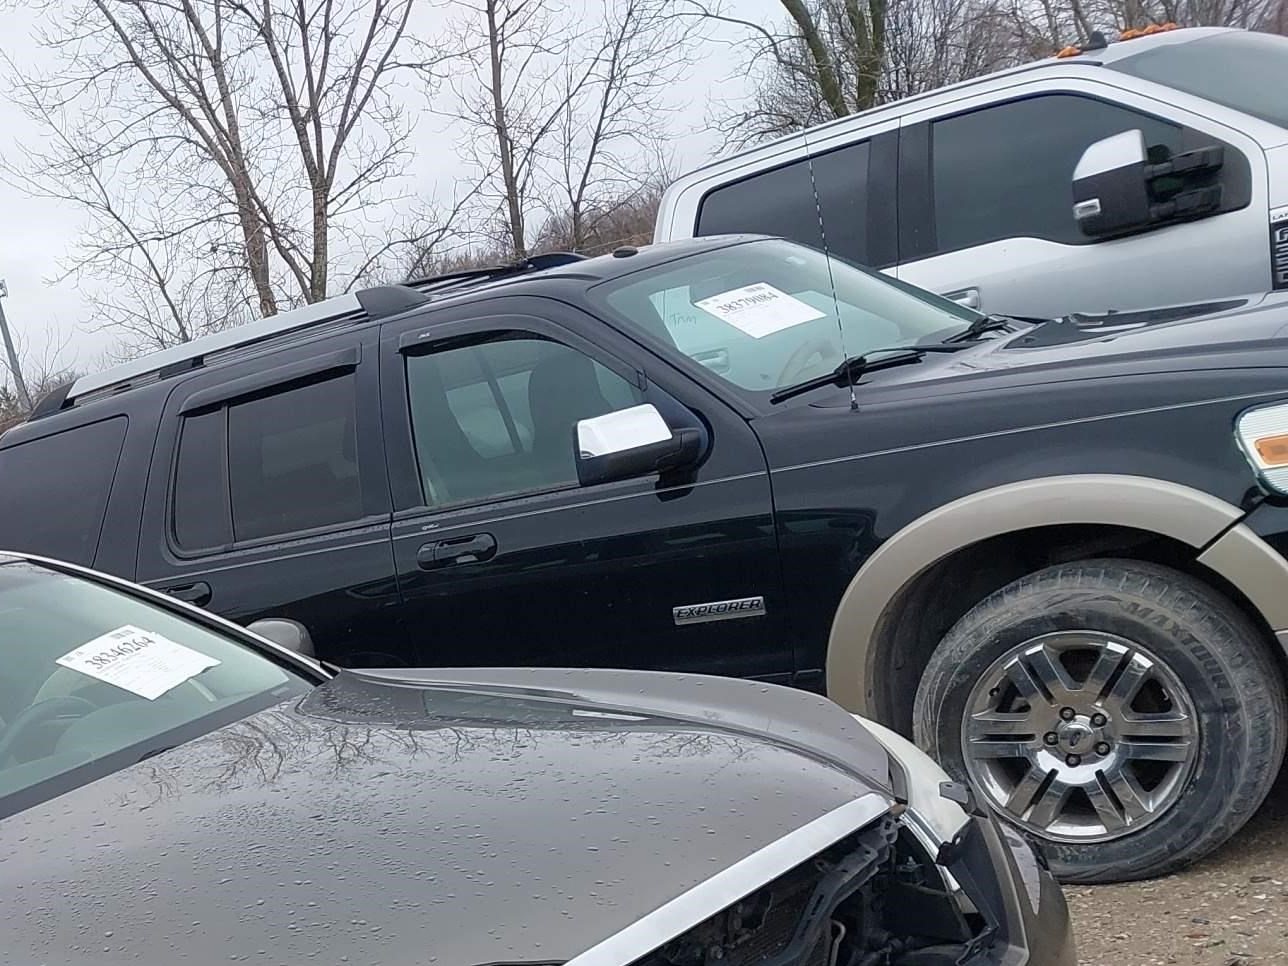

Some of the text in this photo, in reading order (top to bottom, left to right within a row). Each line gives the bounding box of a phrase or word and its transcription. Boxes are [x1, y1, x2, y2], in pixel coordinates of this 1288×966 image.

[715, 291, 779, 314] 38379084
[676, 599, 761, 618] EXPLORER
[84, 636, 156, 669] 38346264
